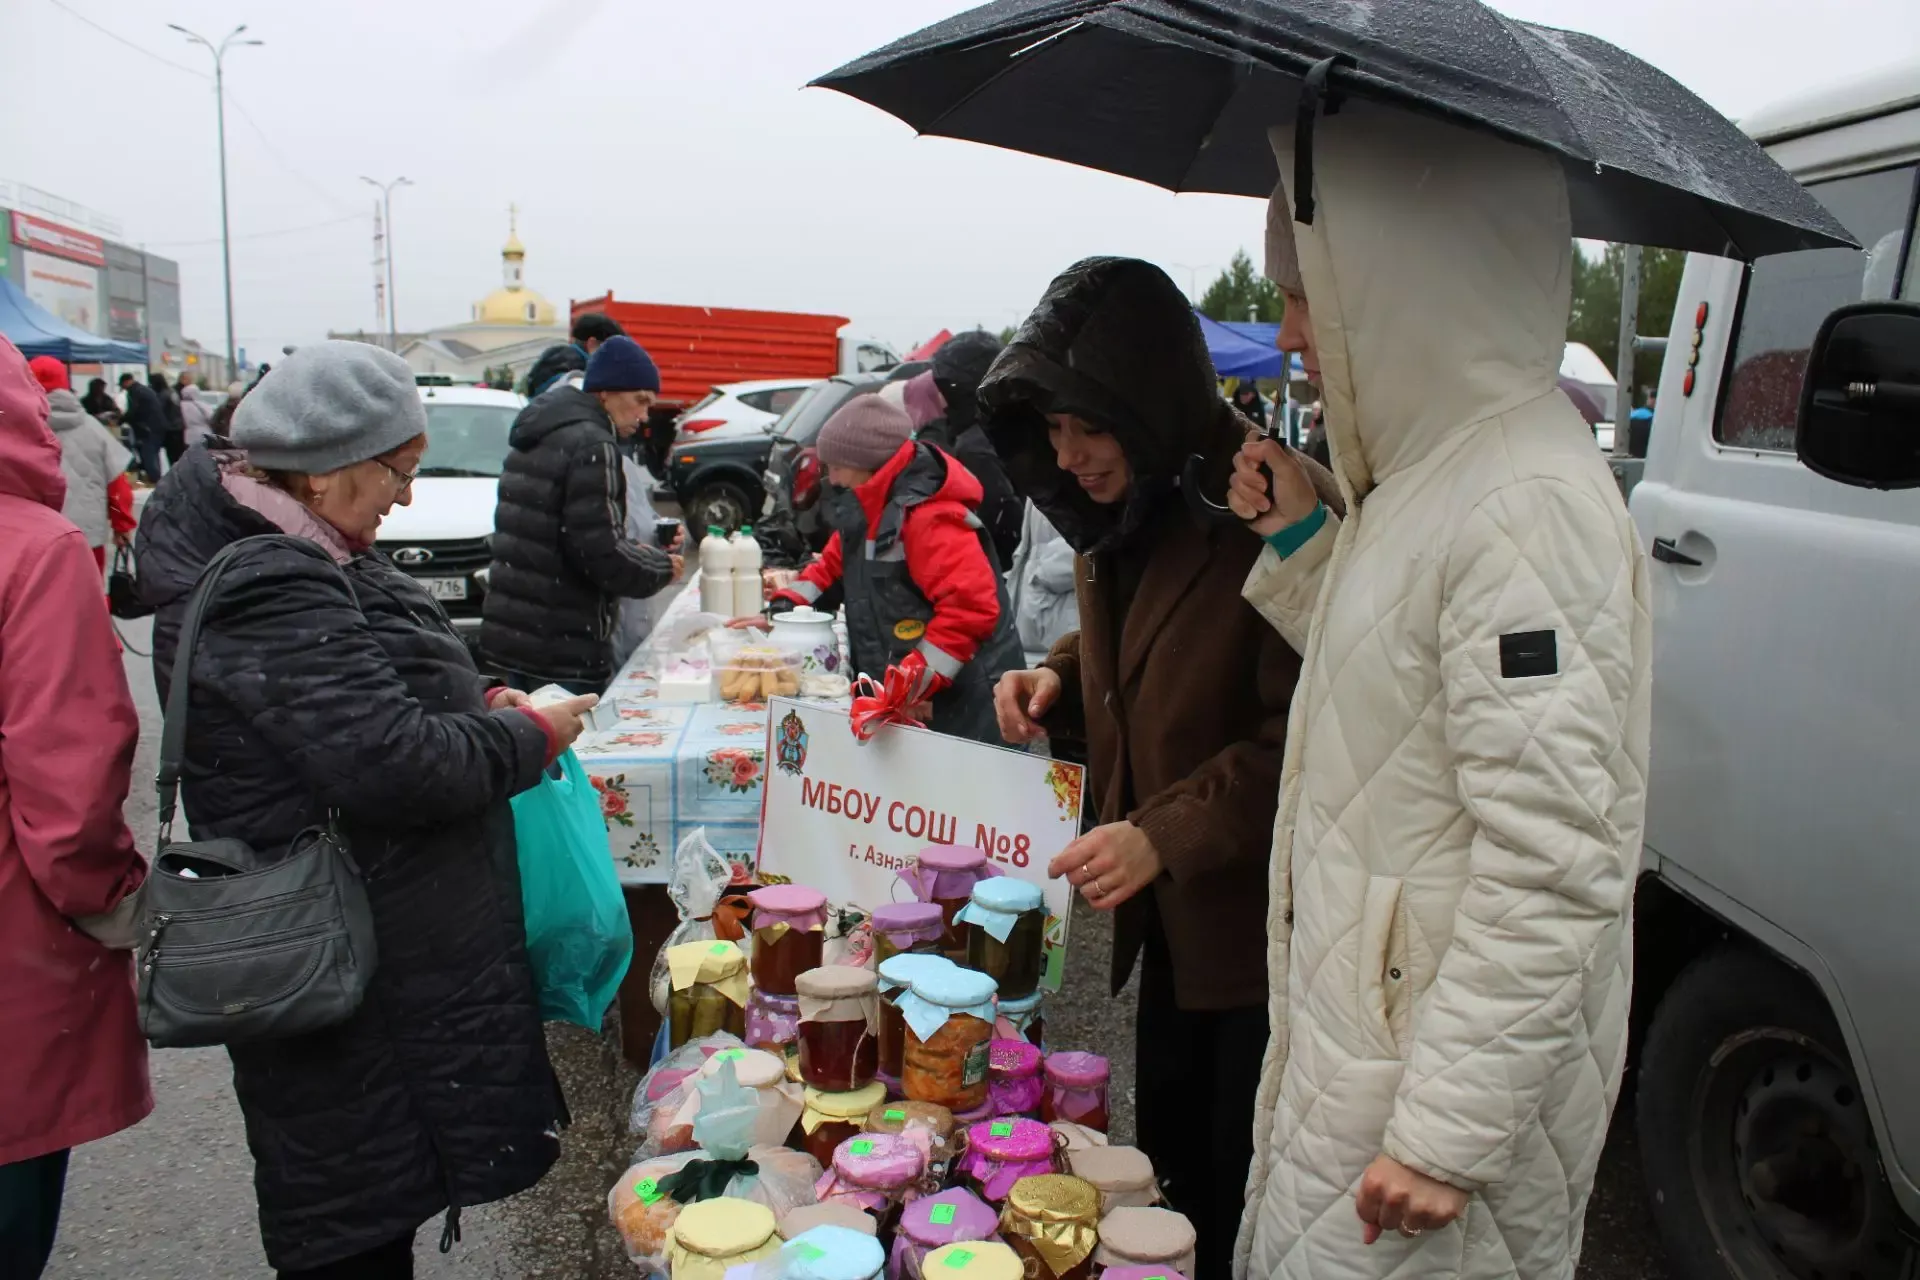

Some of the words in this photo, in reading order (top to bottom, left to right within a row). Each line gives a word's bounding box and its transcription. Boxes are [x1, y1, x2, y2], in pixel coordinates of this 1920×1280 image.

[801, 777, 881, 824] МБОУ
[887, 801, 957, 845] СОШ
[975, 823, 1031, 868] №8
[849, 843, 859, 859] г.
